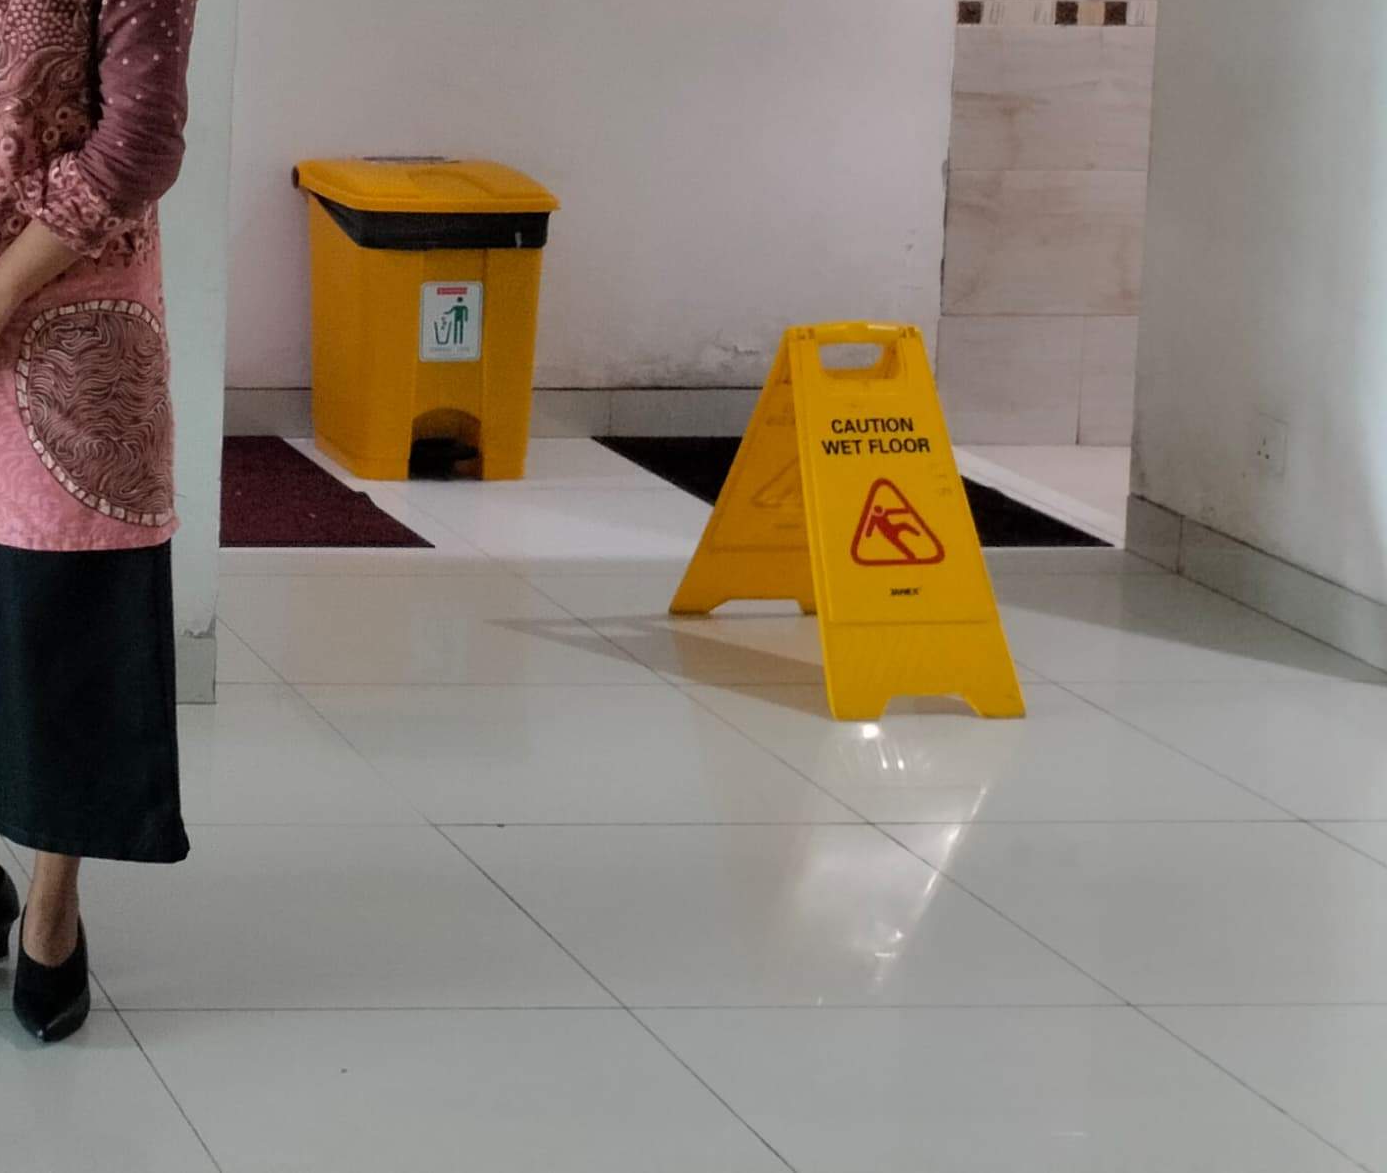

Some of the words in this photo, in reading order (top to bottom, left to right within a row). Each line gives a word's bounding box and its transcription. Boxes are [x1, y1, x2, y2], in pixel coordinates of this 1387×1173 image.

[831, 417, 915, 434] CAUTION
[821, 439, 861, 455] WET
[868, 437, 931, 454] FLOOR
